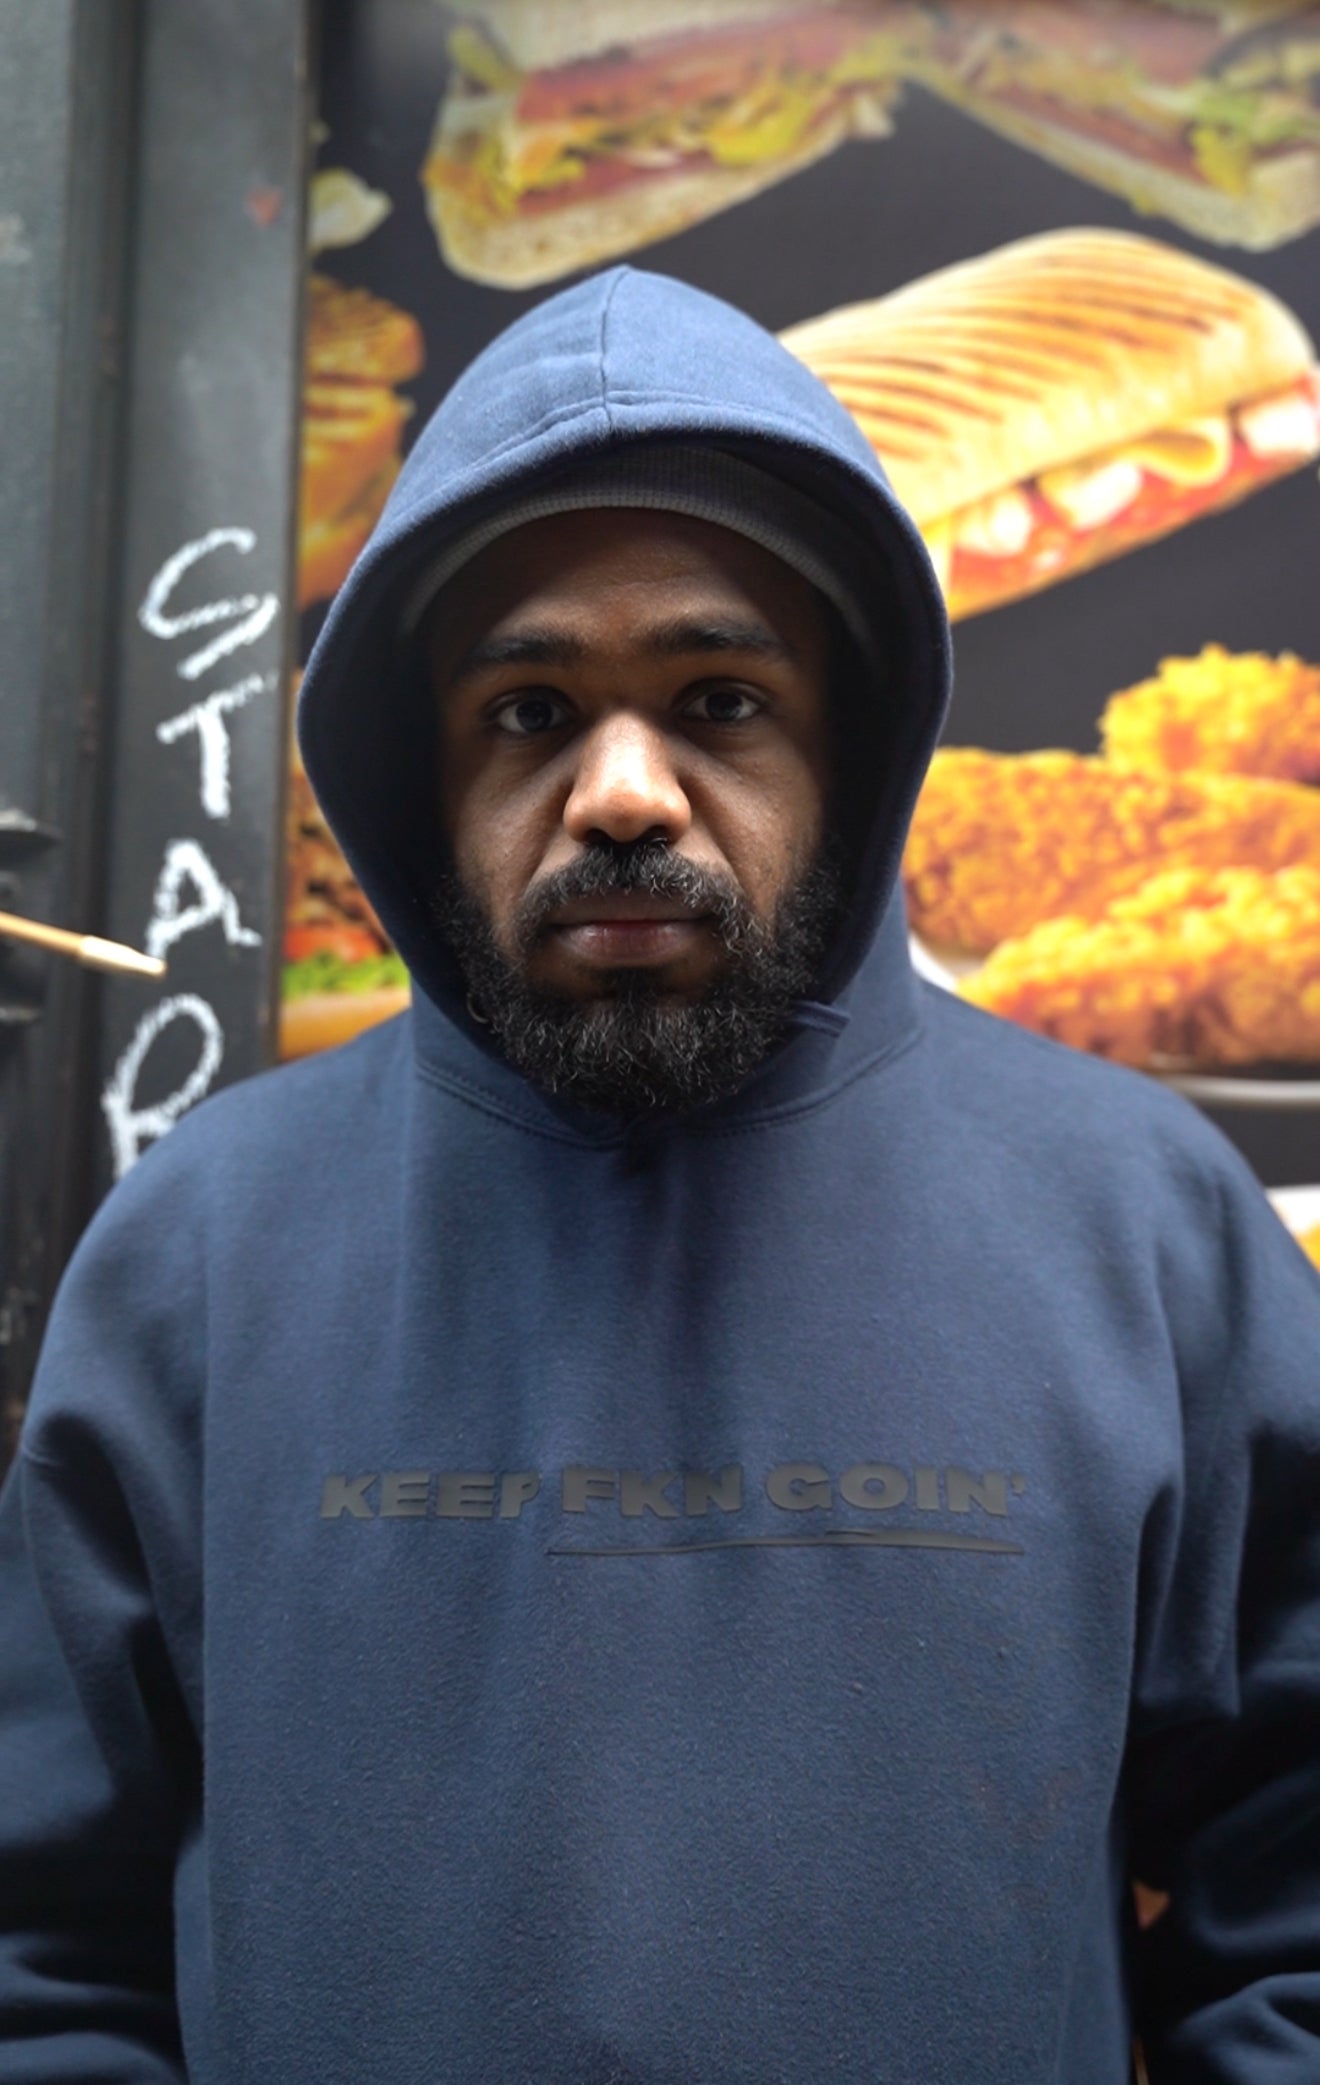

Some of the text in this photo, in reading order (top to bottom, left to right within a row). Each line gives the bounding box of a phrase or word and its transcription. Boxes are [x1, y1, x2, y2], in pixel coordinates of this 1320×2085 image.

[319, 1464, 1027, 1519] KEEP FKN GOIN'
